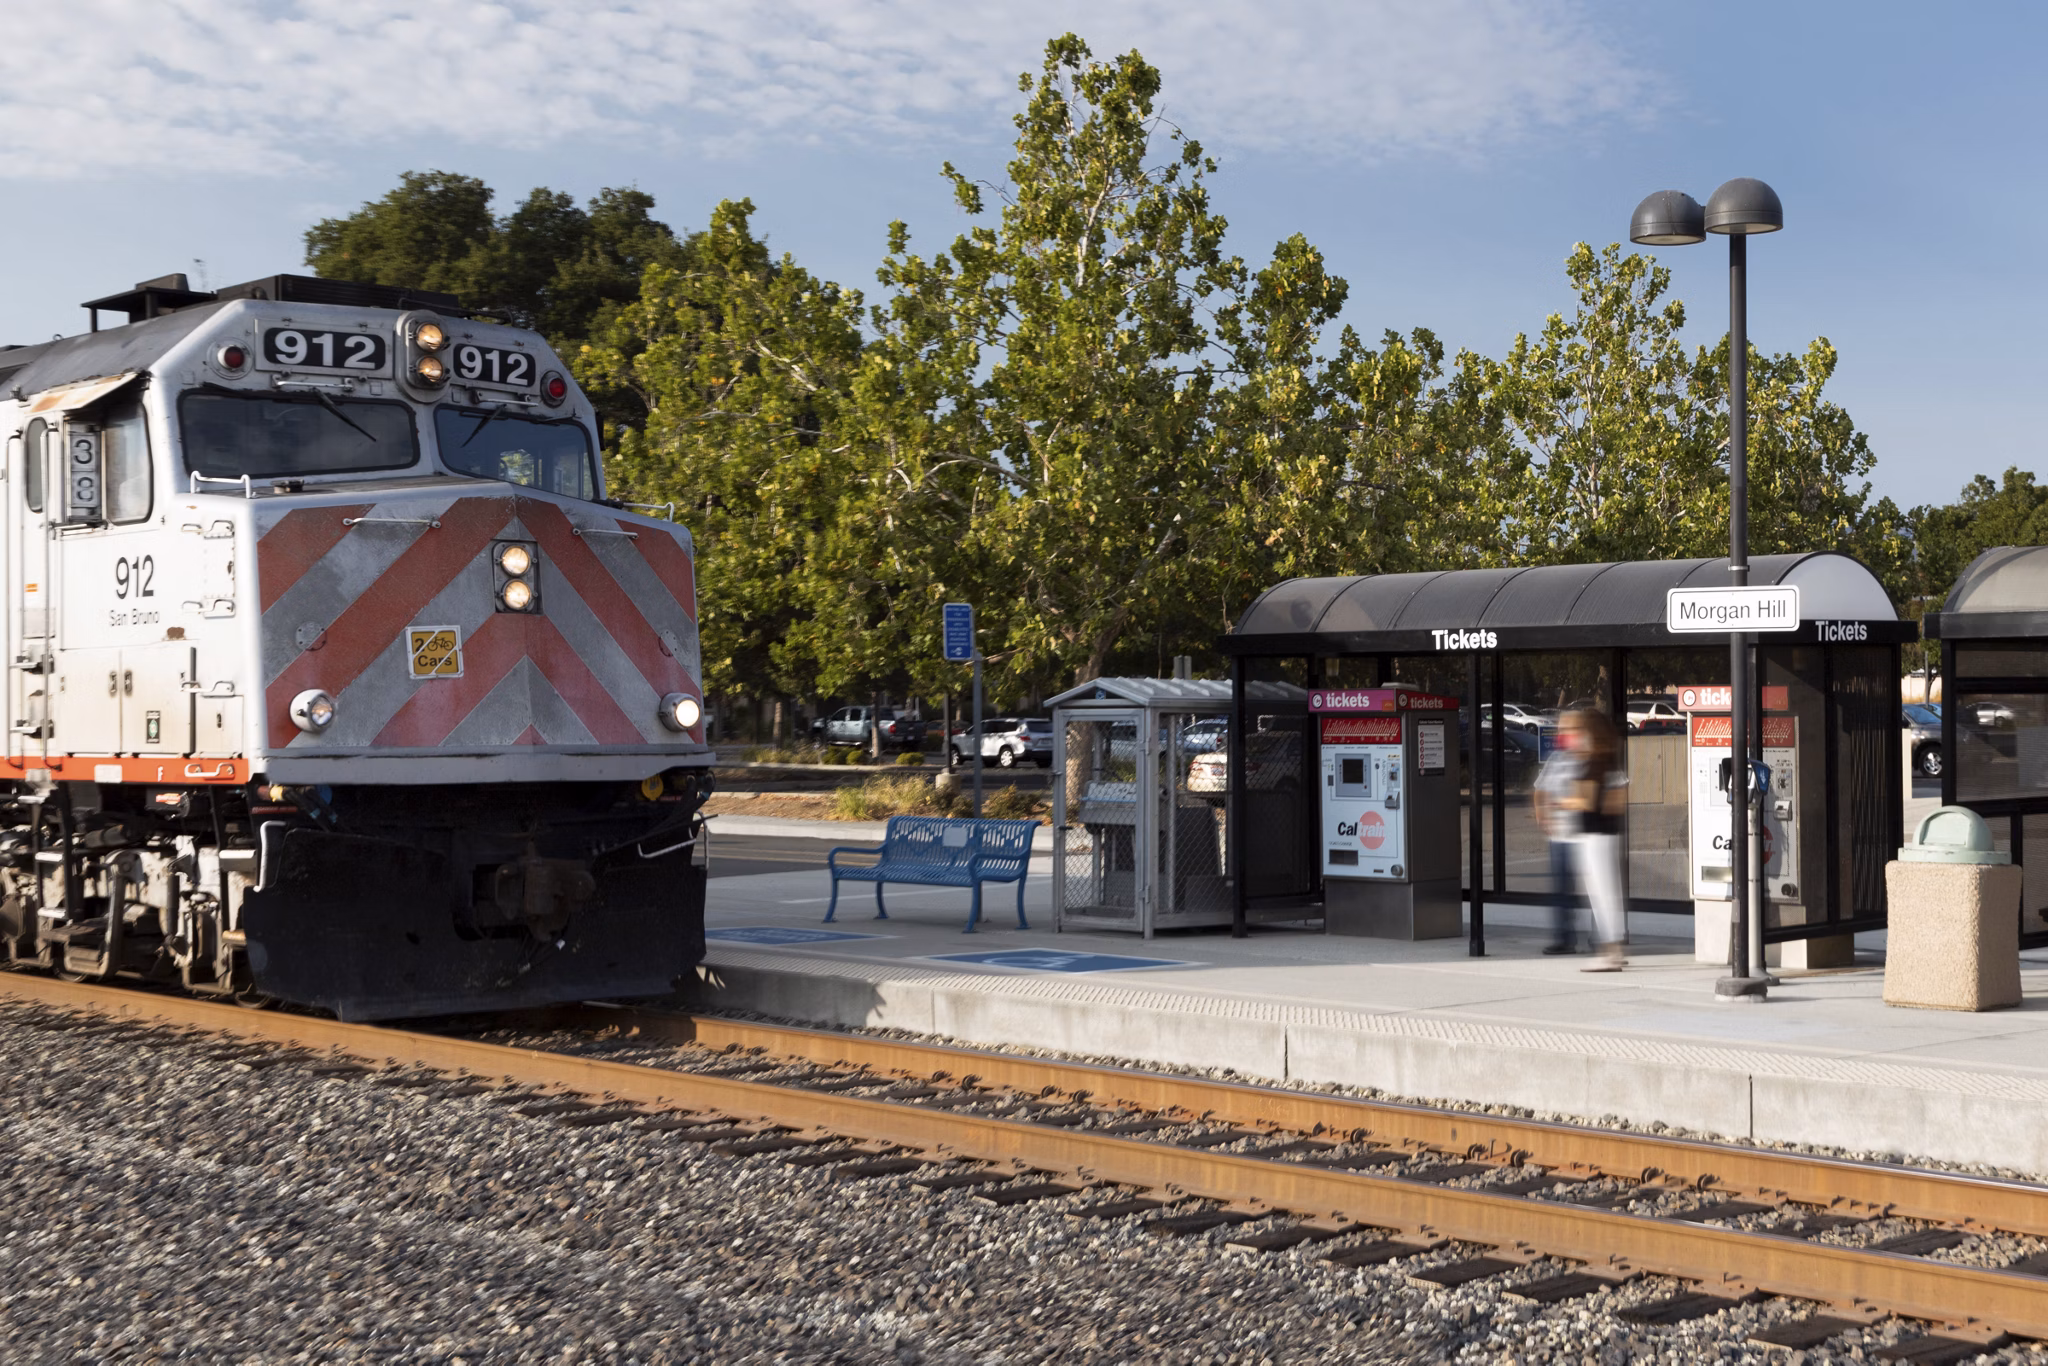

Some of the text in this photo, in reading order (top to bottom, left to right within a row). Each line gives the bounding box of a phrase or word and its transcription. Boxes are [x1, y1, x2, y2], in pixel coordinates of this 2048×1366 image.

[274, 330, 376, 370] 912
[459, 346, 529, 386] 912
[116, 554, 155, 600] 912
[109, 608, 160, 627] San Bruno
[1680, 599, 1787, 624] Morgan Hill
[1431, 628, 1498, 650] Tickets
[1815, 620, 1868, 642] Tickets
[1325, 692, 1370, 708] tickets
[1410, 697, 1444, 709] tickets
